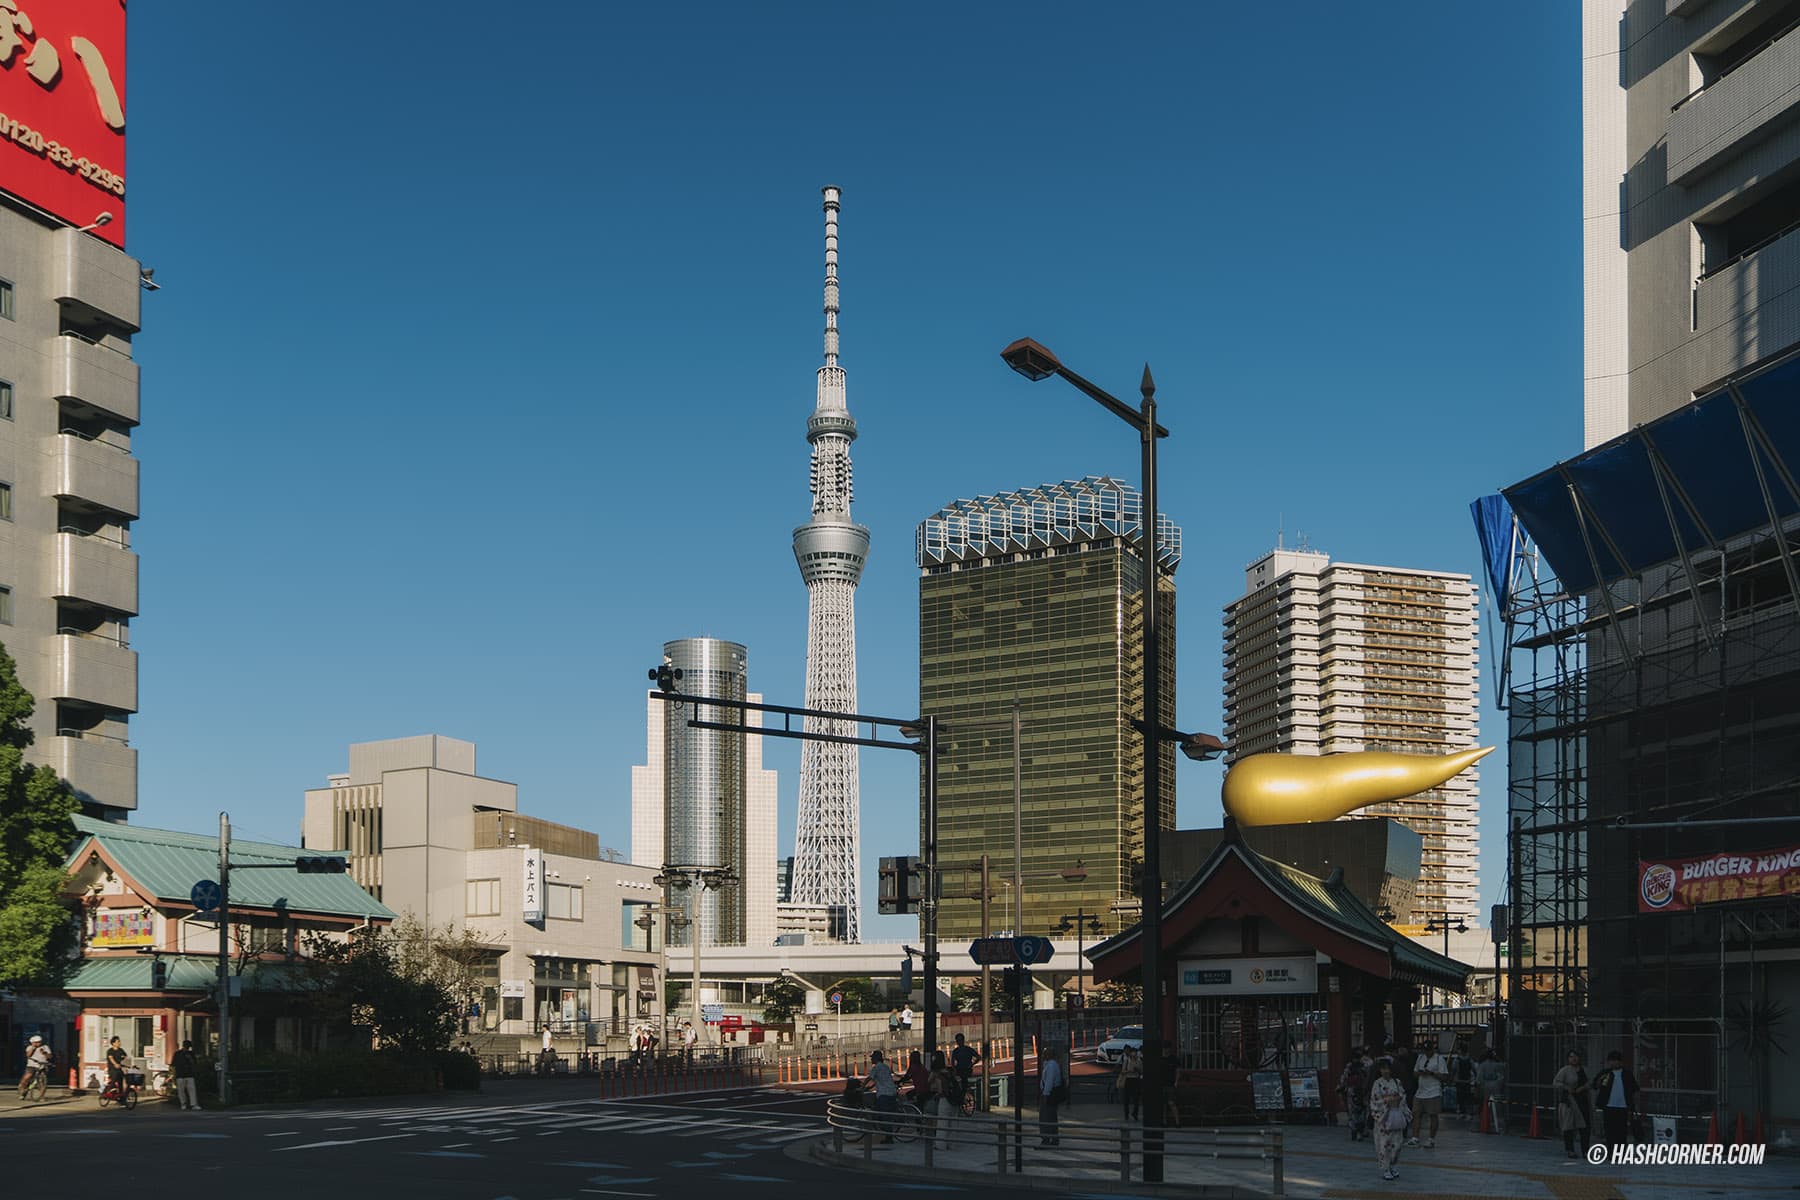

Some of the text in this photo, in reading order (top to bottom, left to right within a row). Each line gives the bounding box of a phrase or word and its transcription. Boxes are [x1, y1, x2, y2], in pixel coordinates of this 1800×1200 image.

[1682, 849, 1800, 881] BURGER KING
[526, 857, 535, 904] 水上バス
[1644, 869, 1672, 888] BURGER
[1647, 879, 1672, 898] KING
[1022, 939, 1033, 956] 6
